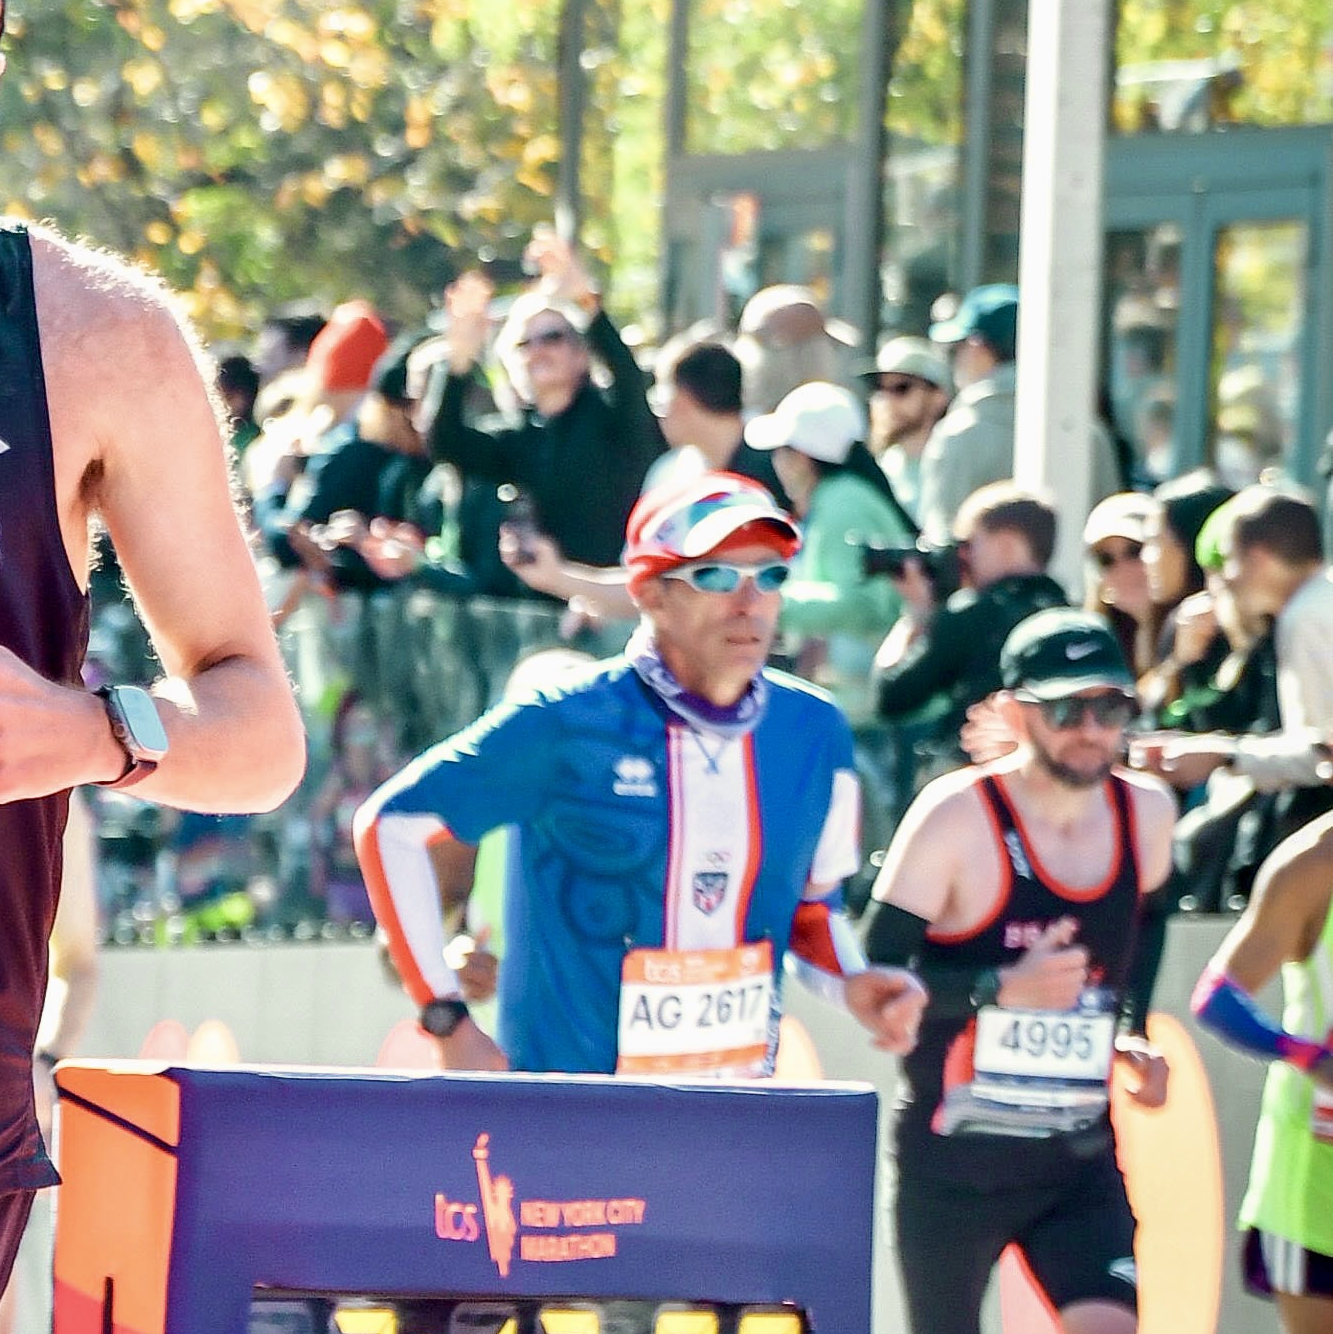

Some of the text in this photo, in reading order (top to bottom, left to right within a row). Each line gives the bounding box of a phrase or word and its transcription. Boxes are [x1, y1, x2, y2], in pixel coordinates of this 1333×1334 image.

[629, 984, 764, 1030] AG 2617
[999, 1019, 1092, 1060] 4995
[434, 1193, 480, 1242] tcs
[520, 1198, 646, 1228] NEW YORK CITY
